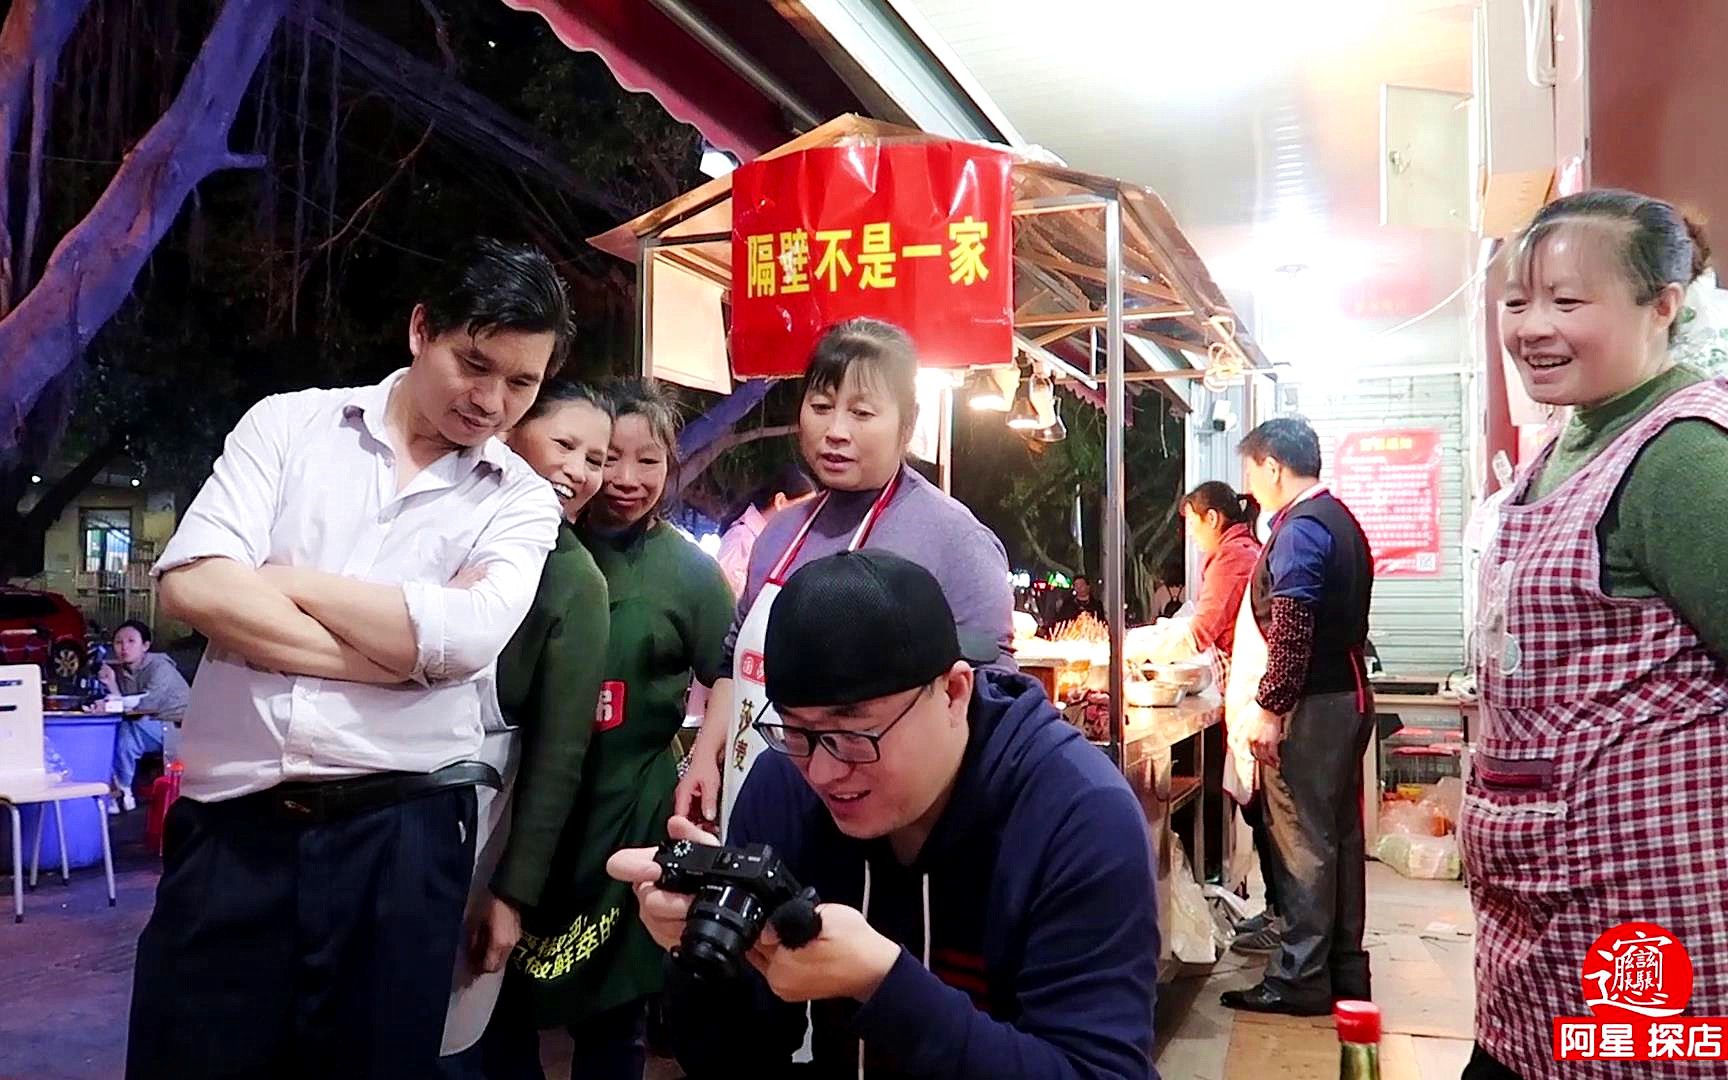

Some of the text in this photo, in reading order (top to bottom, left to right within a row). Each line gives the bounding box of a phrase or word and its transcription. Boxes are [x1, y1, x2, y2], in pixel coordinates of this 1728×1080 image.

[747, 215, 990, 299] 隔壁不是一家
